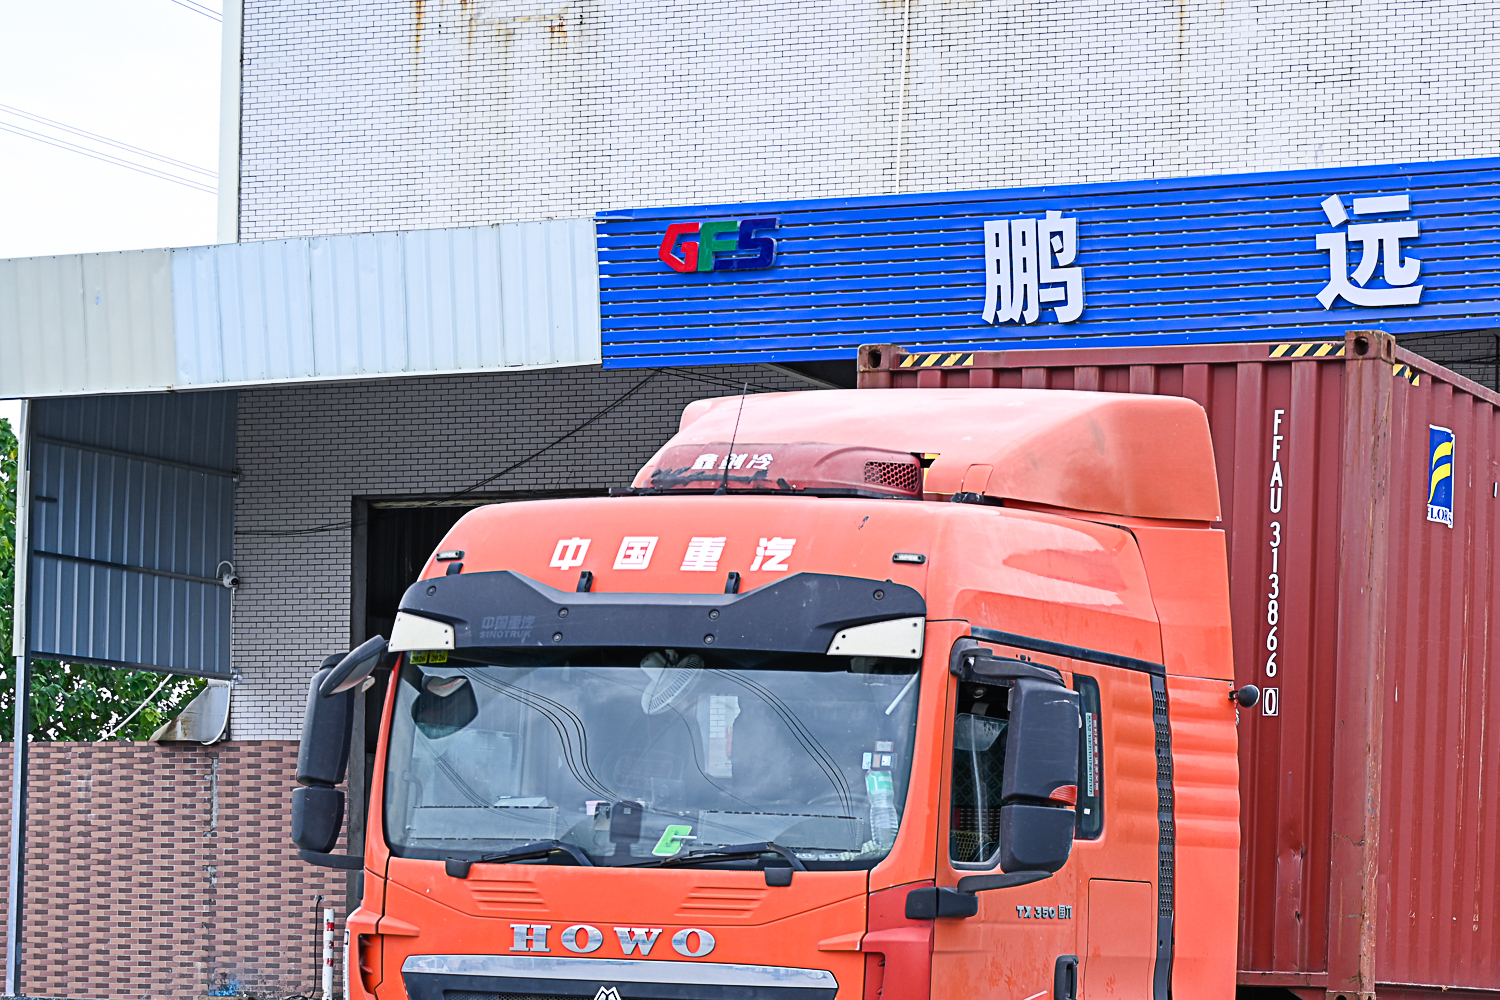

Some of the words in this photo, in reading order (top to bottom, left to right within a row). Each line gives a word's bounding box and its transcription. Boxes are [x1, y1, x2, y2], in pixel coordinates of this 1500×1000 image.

[658, 216, 779, 274] GFS
[1269, 409, 1285, 514] FFAU
[548, 535, 798, 573] 中国重汽
[1265, 521, 1282, 678] 313866
[1016, 905, 1032, 919] TX
[1034, 906, 1056, 919] 350
[509, 922, 716, 958] HOWO
